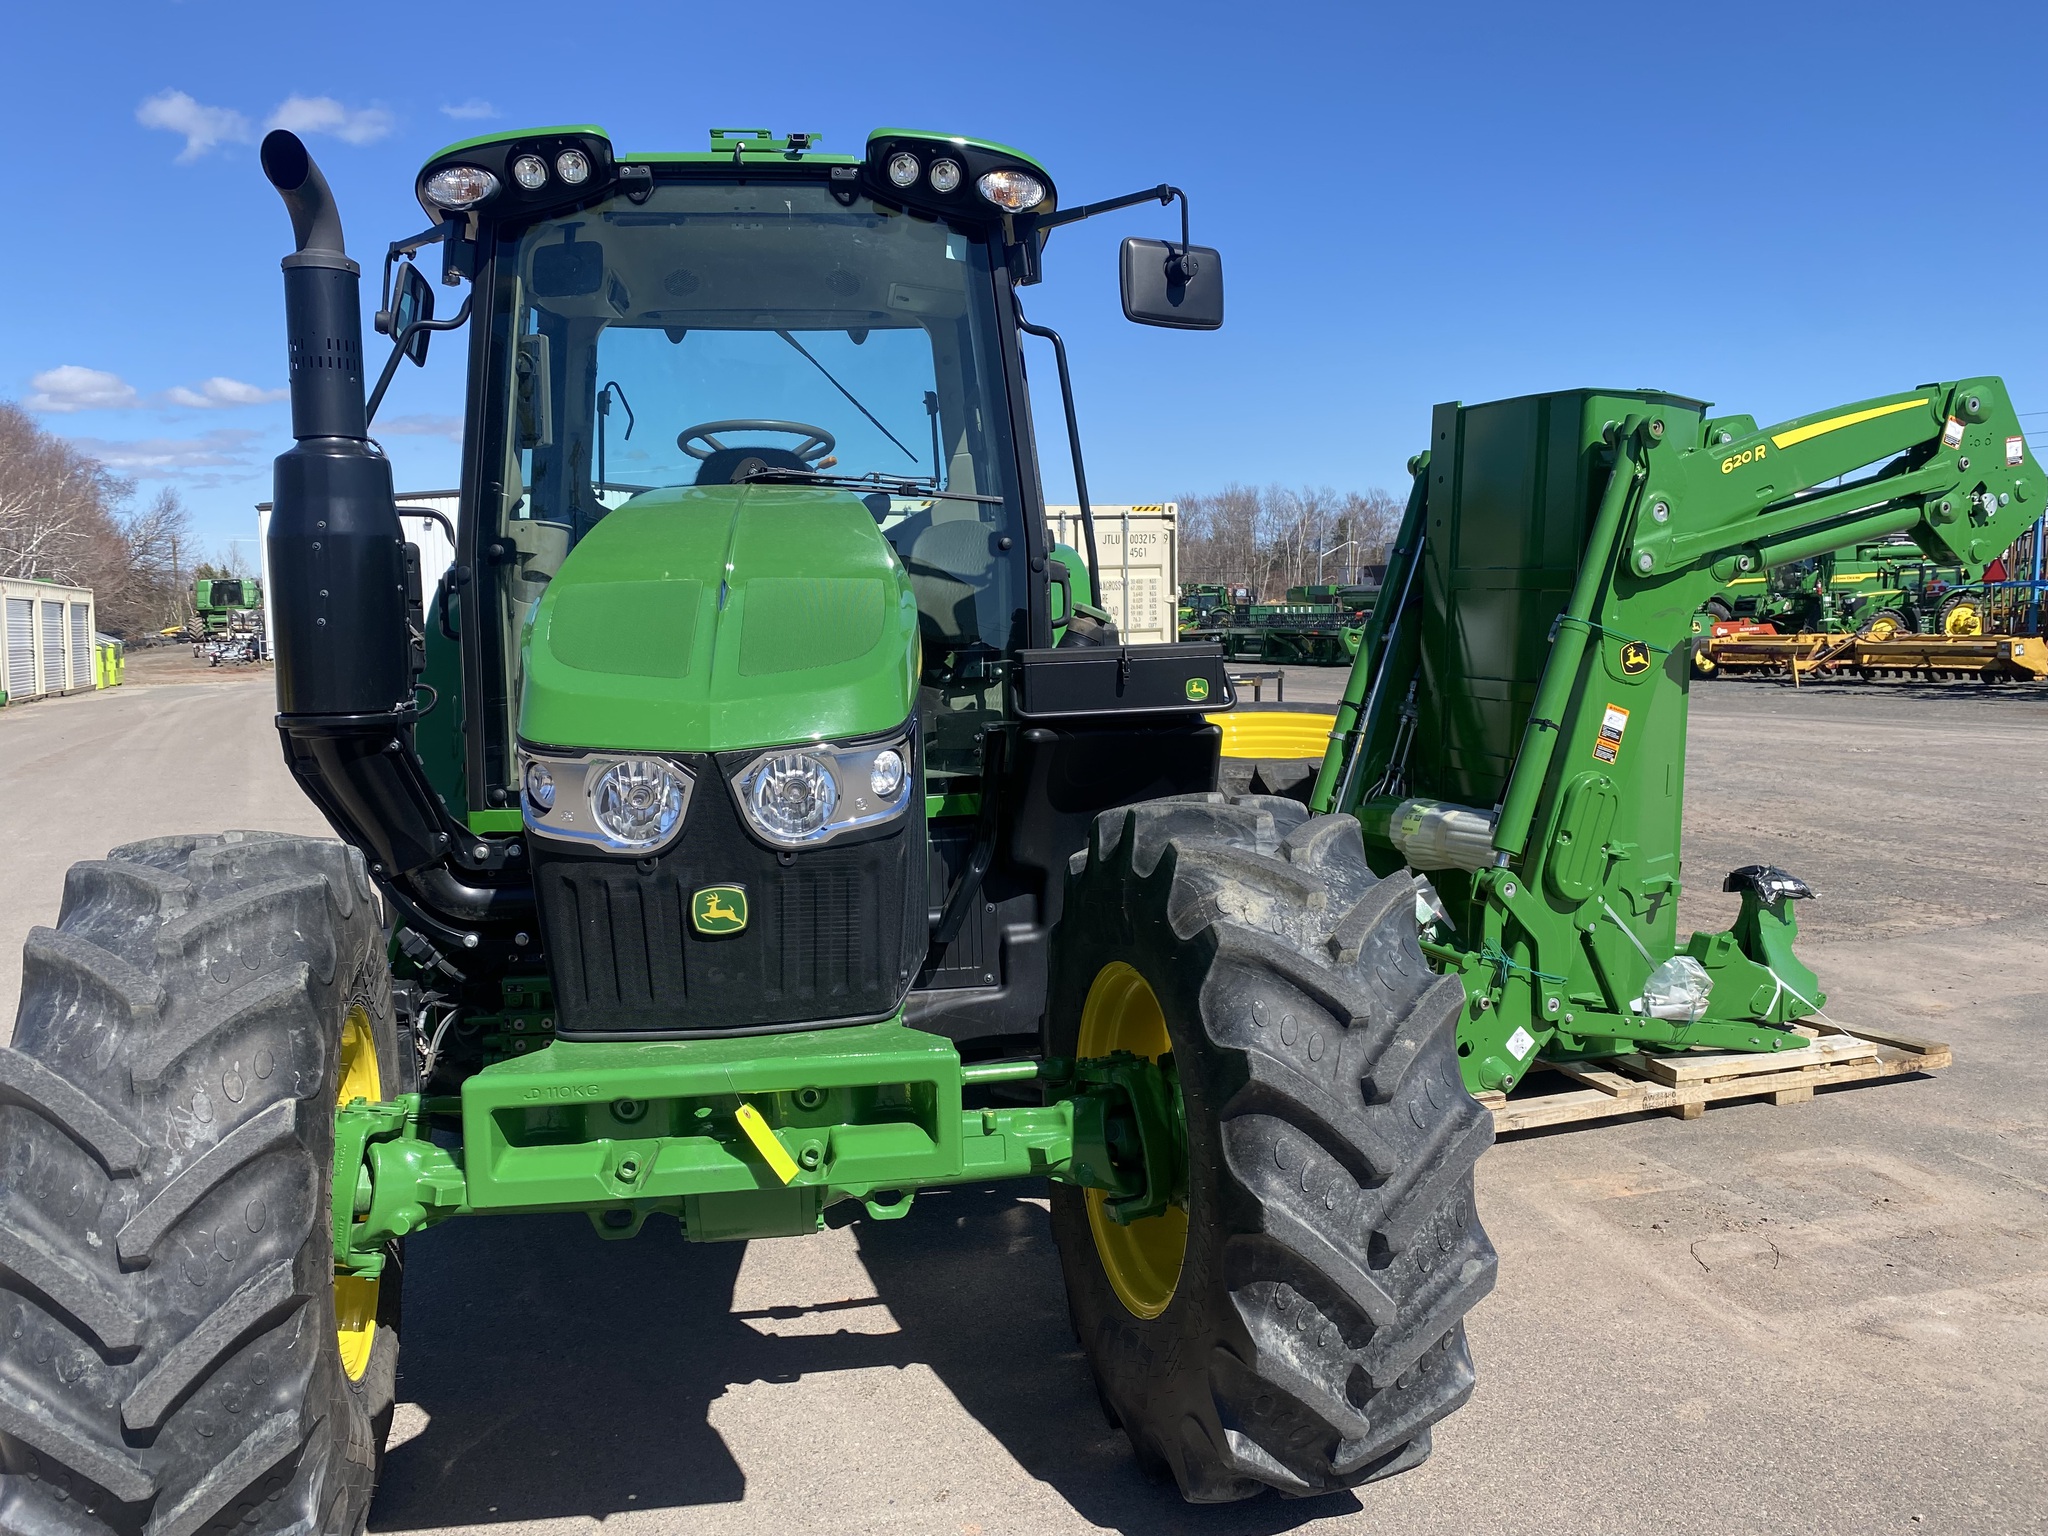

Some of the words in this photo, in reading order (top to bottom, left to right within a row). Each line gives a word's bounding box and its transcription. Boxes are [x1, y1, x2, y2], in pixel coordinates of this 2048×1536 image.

[1102, 534, 1121, 545] JTLU
[1129, 533, 1157, 545] 003215
[1129, 547, 1147, 558] 45G1
